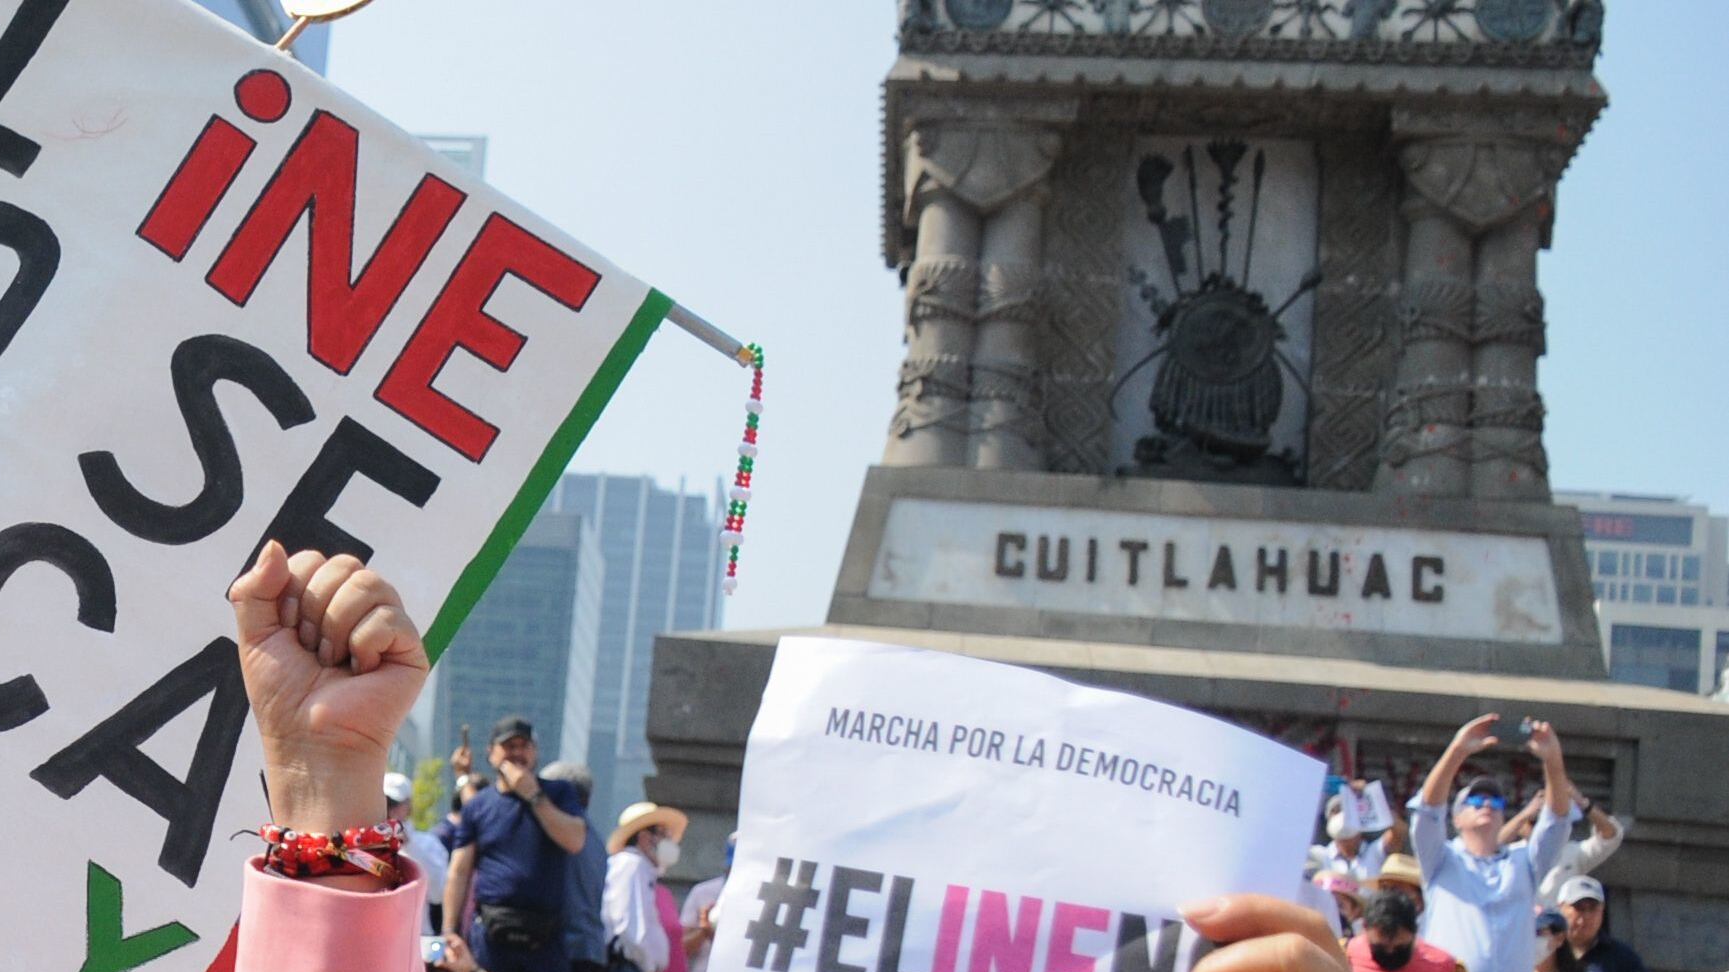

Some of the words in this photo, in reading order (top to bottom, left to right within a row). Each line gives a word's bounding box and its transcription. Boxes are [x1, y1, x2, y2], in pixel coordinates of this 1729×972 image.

[994, 532, 1445, 603] CUITLAHUAC
[825, 707, 940, 752] MARCHA
[949, 725, 1005, 760] POR
[1012, 735, 1045, 768] LA
[1056, 743, 1242, 818] DEMOCRACIA
